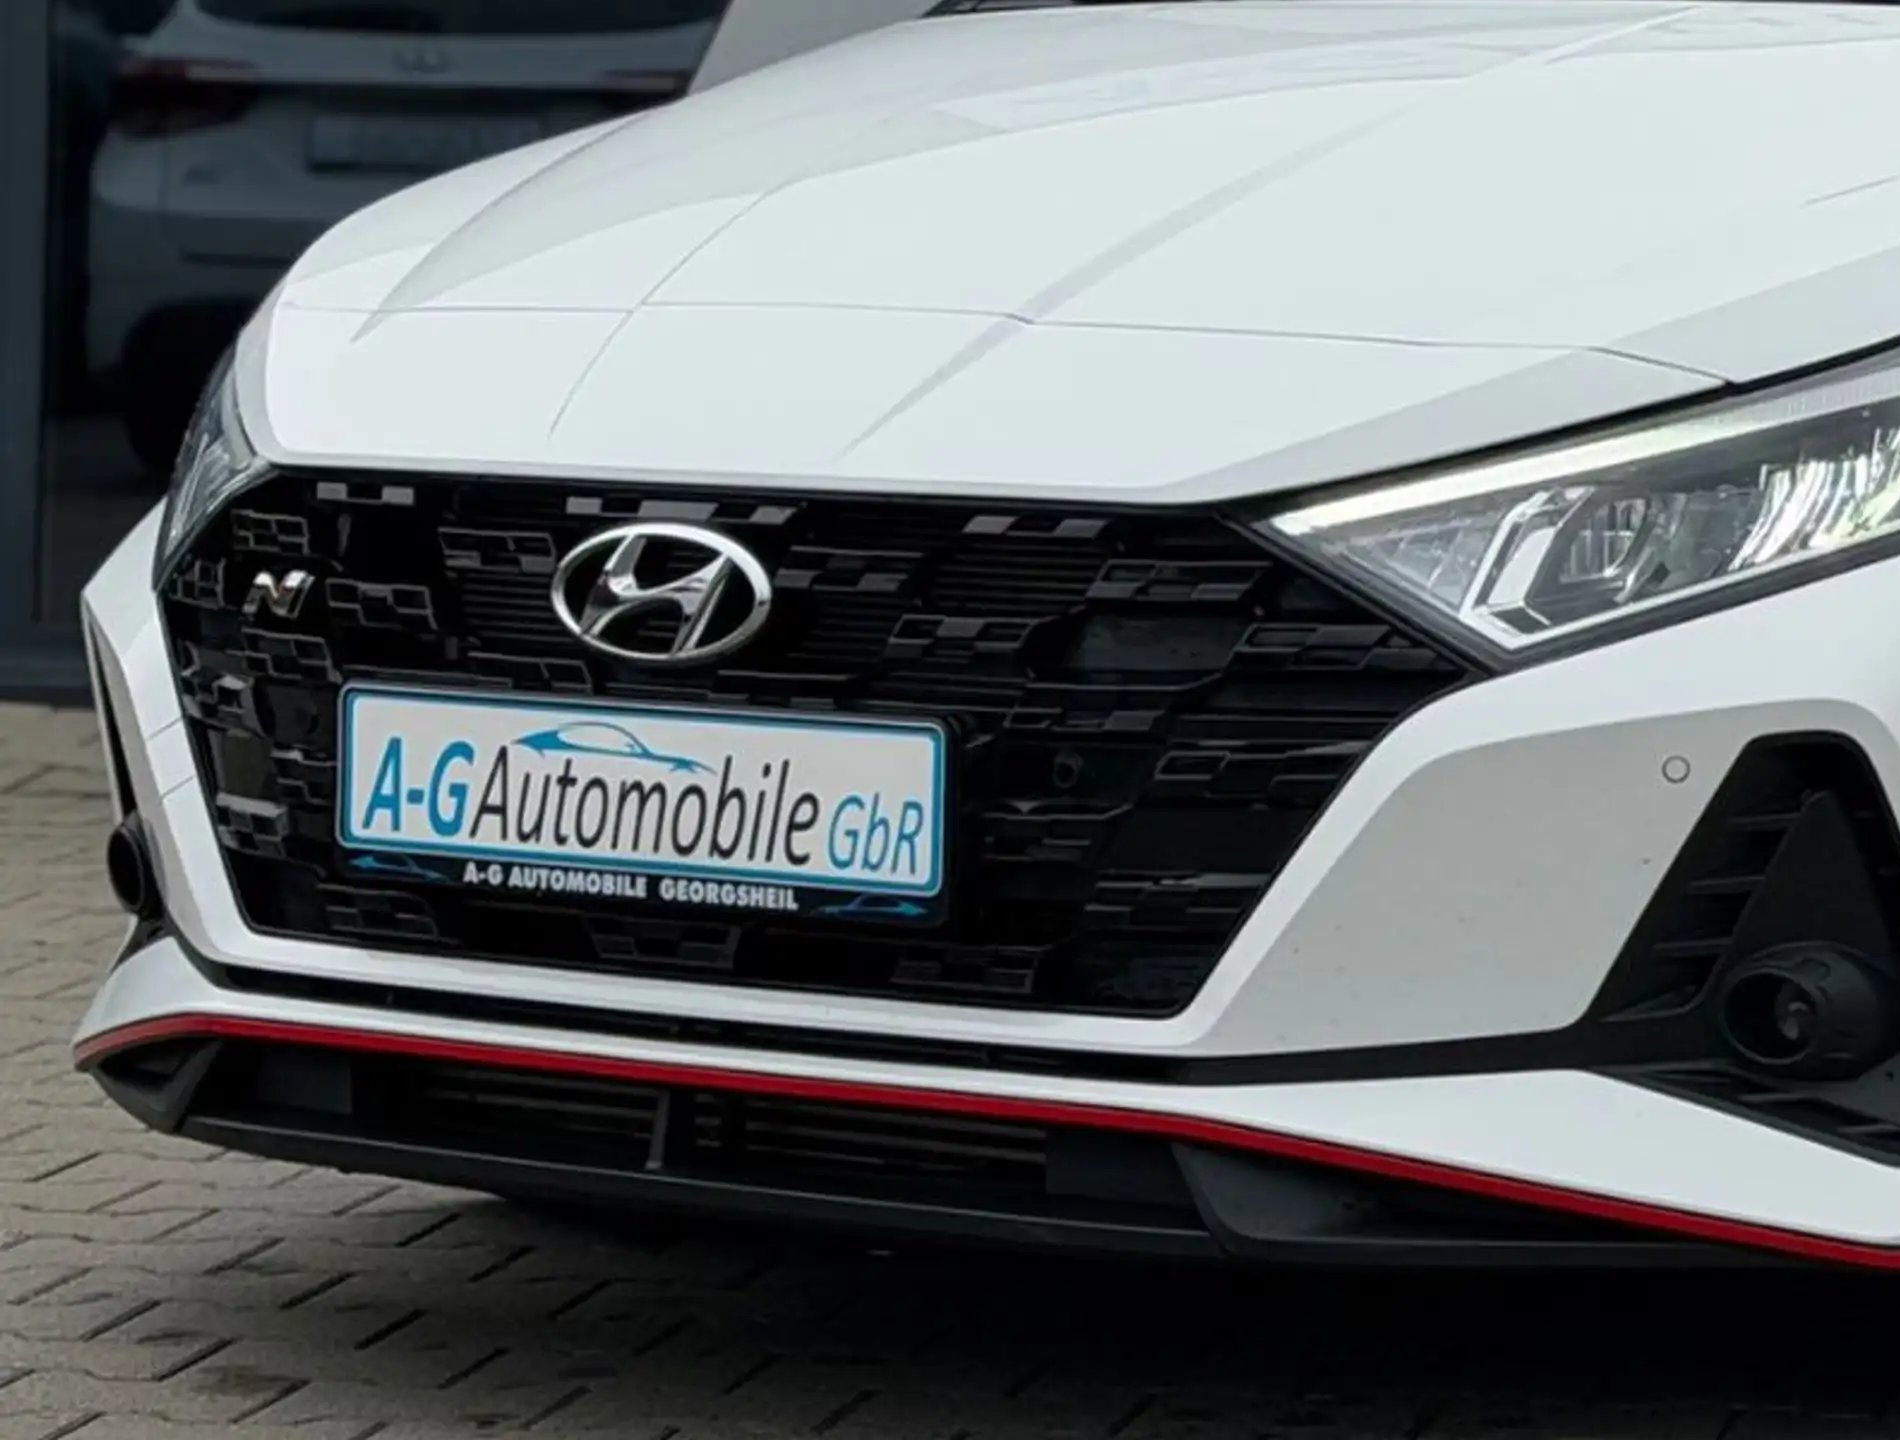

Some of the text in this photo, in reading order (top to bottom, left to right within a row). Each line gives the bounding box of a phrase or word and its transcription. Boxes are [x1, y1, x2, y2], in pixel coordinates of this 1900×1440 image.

[827, 793, 924, 875] GbR
[463, 861, 800, 911] A-G AUTOMOBILE GEORGSHEIL
